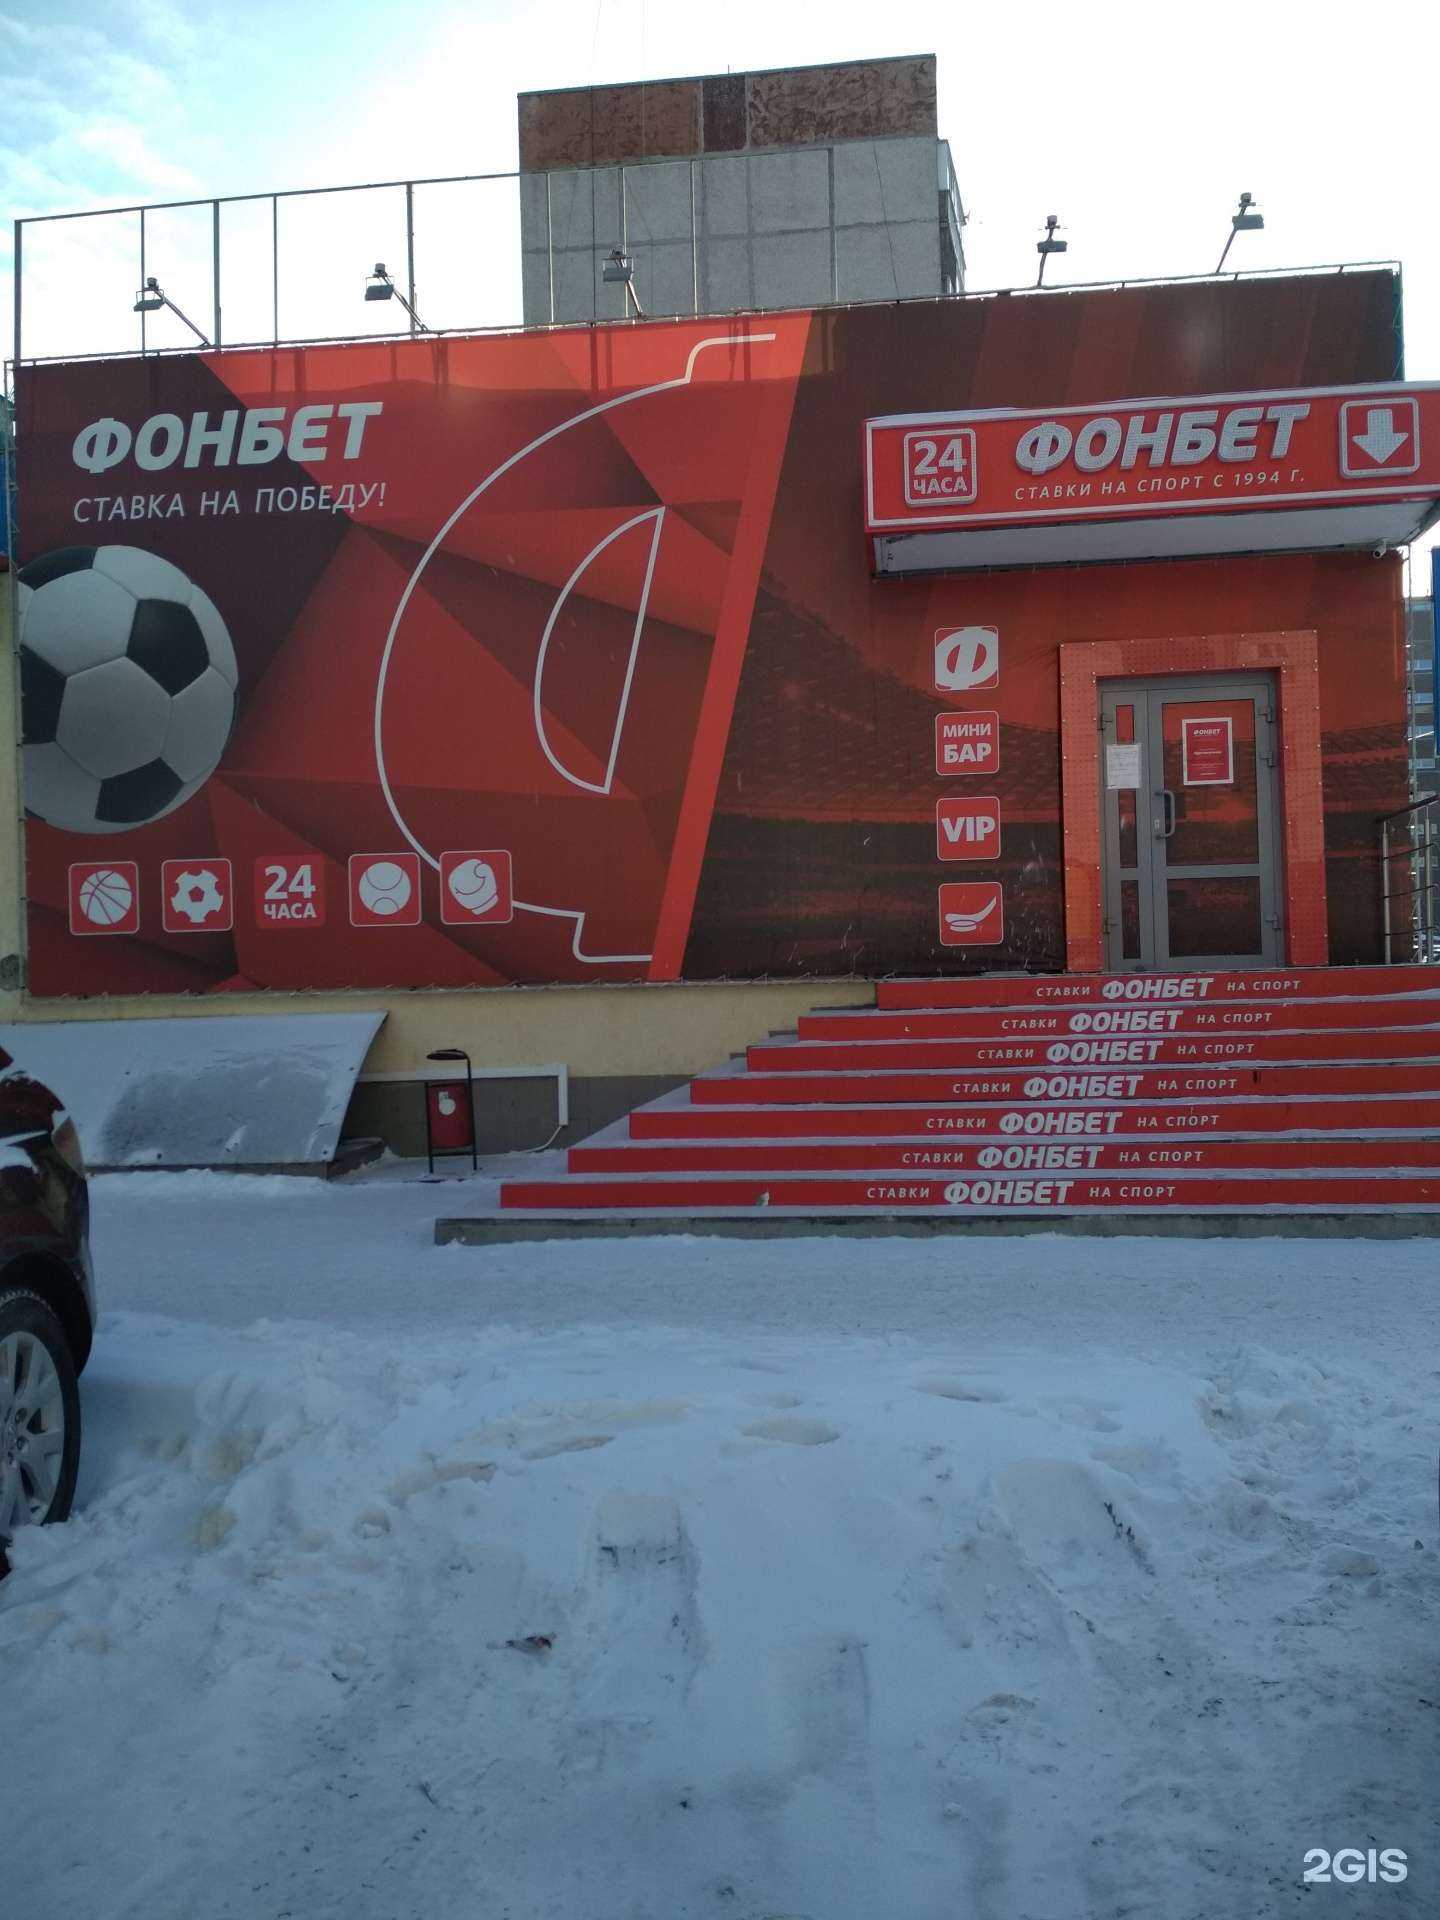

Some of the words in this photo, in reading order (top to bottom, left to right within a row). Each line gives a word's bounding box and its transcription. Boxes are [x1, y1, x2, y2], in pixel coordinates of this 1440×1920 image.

[72, 402, 383, 474] ФОНБЕТ
[1014, 404, 1310, 475] ФОНБЕТ
[913, 438, 968, 477] 24
[913, 476, 968, 496] ЧАСА
[1015, 482, 1092, 500] СТАВКИ
[1101, 480, 1126, 495] НА
[1137, 476, 1203, 491] СПОРТ
[1213, 474, 1224, 488] С
[1234, 471, 1280, 487] 1994
[1290, 469, 1304, 483] Г.
[73, 493, 186, 523] СТАВКА
[199, 490, 242, 515] НА
[255, 482, 387, 514] ПОБЕДУ!
[943, 723, 992, 738] МИНИ
[943, 743, 992, 763] БАР
[941, 816, 995, 842] VIP
[263, 865, 316, 900] 24
[263, 902, 317, 920] ЧАСА
[1036, 986, 1090, 997] СТАВКИ
[1102, 978, 1214, 1000] ФОНБЕТ
[1227, 981, 1246, 991] НА
[1253, 980, 1301, 990] СПОРТ
[1002, 1019, 1057, 1029] СТАВКИ
[1069, 1010, 1183, 1032] ФОНБЕТ
[1197, 1013, 1216, 1024] НА
[1223, 1012, 1272, 1023] СПОРТ
[977, 1049, 1034, 1059] СТАВКИ
[1046, 1040, 1163, 1064] ФОНБЕТ
[1178, 1045, 1196, 1055] НА
[1204, 1043, 1254, 1054] СПОРТ
[953, 1083, 1011, 1094] СТАВКИ
[1023, 1075, 1143, 1098] ФОНБЕТ
[1158, 1080, 1178, 1090] НА
[1186, 1079, 1237, 1090] СПОРТ
[926, 1118, 986, 1129] СТАВКИ
[999, 1112, 1122, 1134] ФОНБЕТ
[1137, 1116, 1158, 1127] НА
[1165, 1115, 1219, 1126] СПОРТ
[902, 1152, 963, 1163] СТАВКИ
[977, 1146, 1104, 1169] ФОНБЕТ
[1119, 1151, 1140, 1162] НА
[1149, 1150, 1204, 1162] СПОРТ
[867, 1187, 929, 1198] СТАВКИ
[944, 1181, 1074, 1204] ФОНБЕТ
[1090, 1187, 1111, 1198] НА
[1119, 1186, 1176, 1198] СПОРТ
